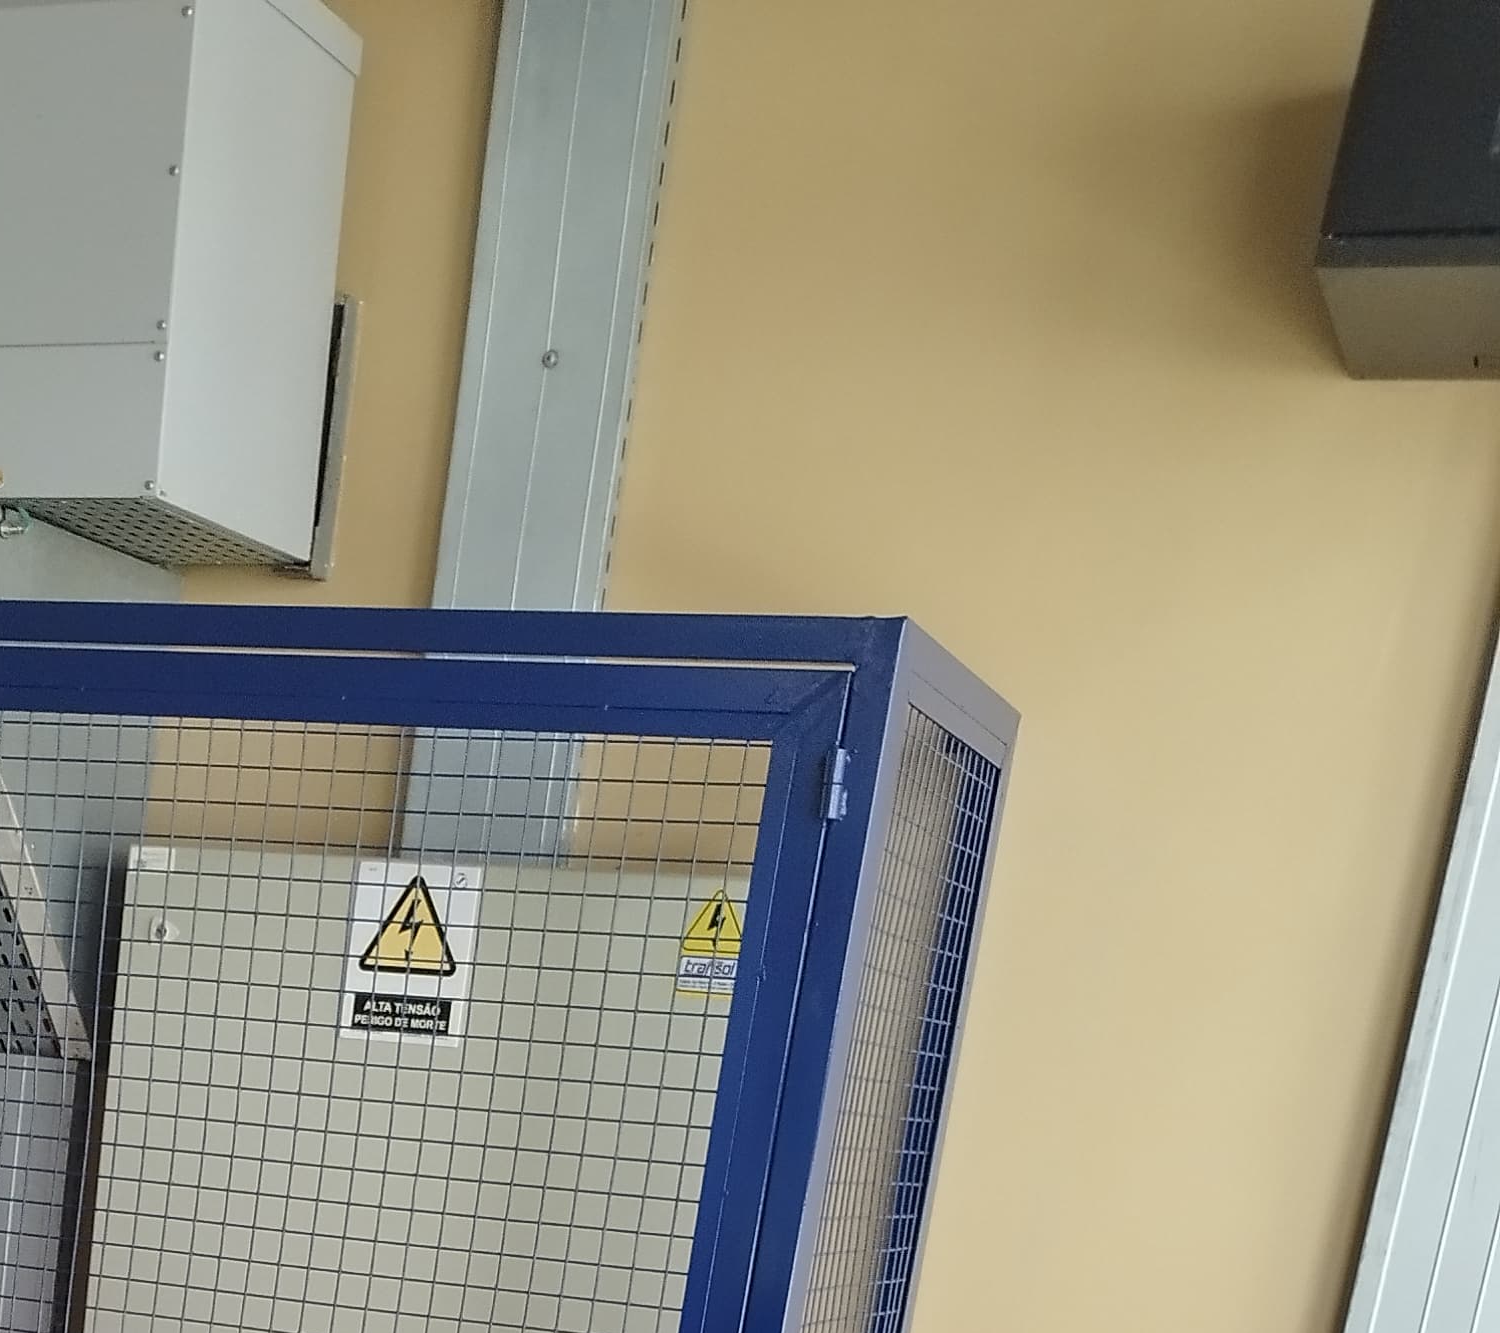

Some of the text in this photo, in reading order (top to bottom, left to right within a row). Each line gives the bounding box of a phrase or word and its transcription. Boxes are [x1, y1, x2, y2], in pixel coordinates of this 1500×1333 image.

[363, 1000, 441, 1016] ALTA TENSÃO
[354, 1014, 447, 1031] PERIGO DE MORTE
